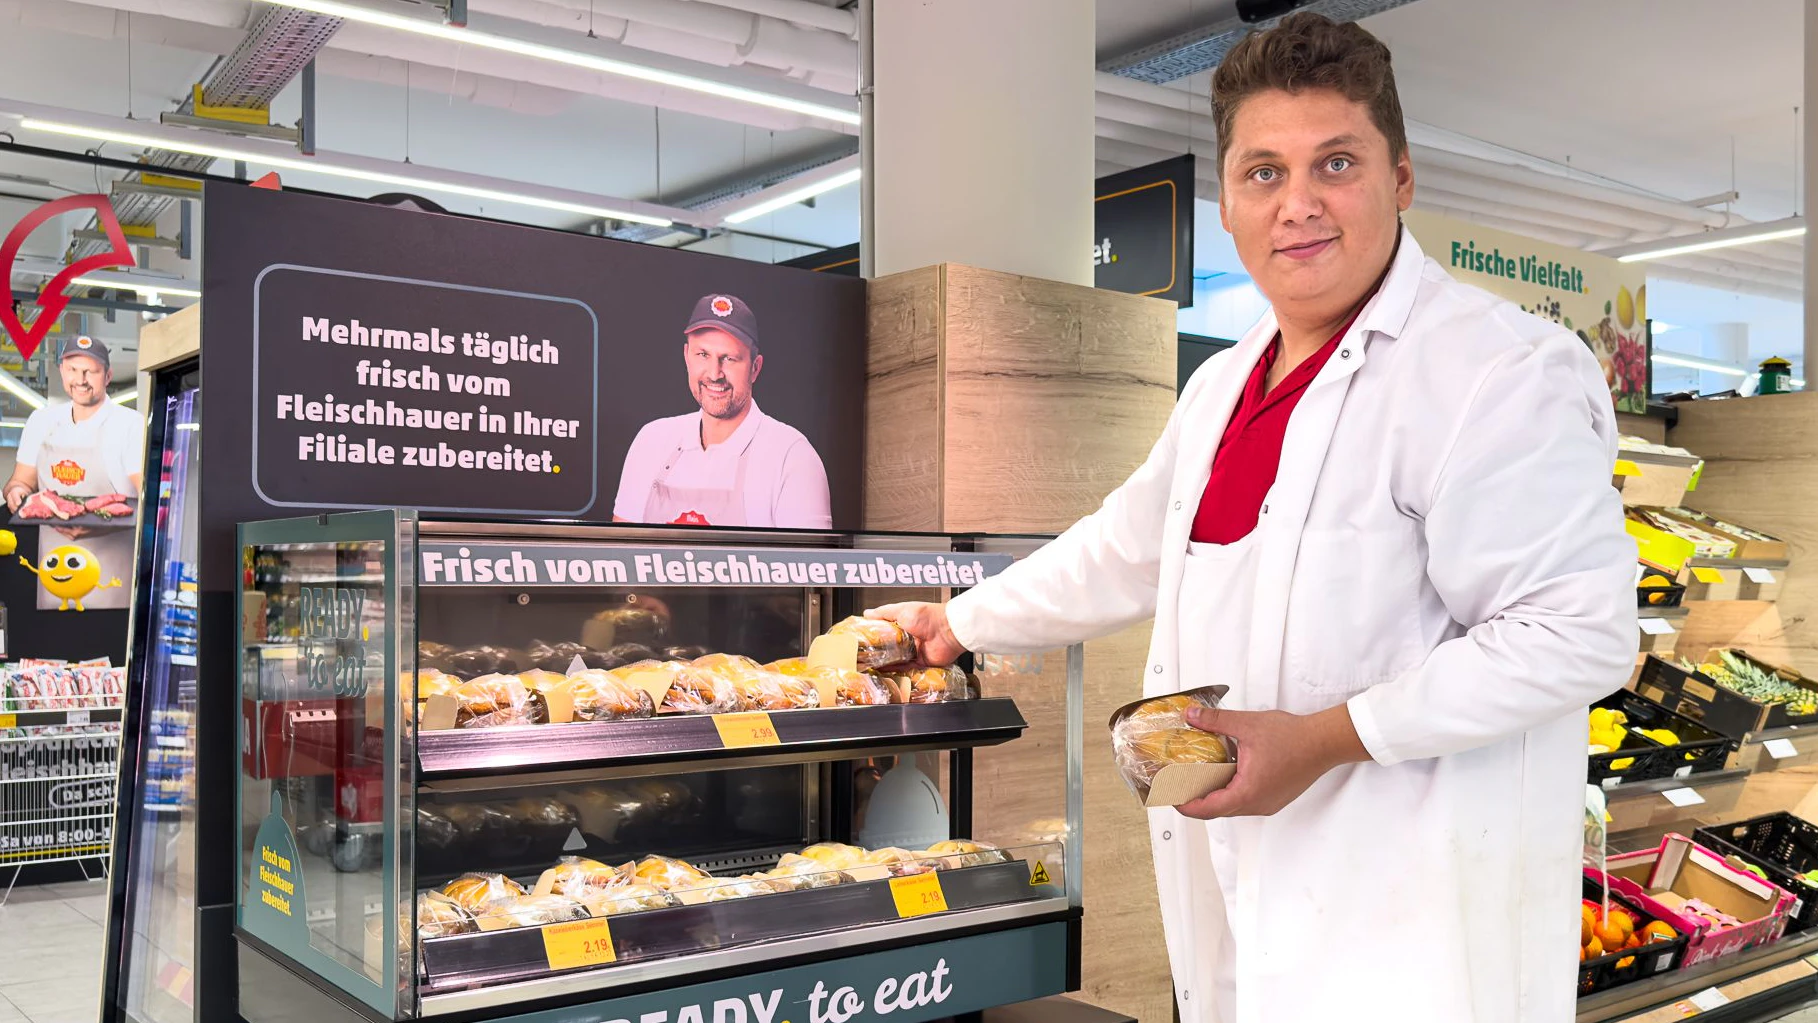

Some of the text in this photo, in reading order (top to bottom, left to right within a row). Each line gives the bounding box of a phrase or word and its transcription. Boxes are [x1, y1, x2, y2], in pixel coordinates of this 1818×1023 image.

[1451, 240, 1590, 294] Frische Vielfalt.
[302, 316, 559, 365] Mehrmals täglich
[356, 359, 510, 397] frisch vom
[277, 393, 580, 438] Fleischhauer in Ihrer
[298, 432, 561, 474] Filiale zubereitet.
[422, 547, 538, 582] Frisch
[544, 558, 627, 583] vom
[634, 551, 838, 584] Fleischhauer
[300, 587, 369, 641] READY.
[304, 638, 369, 698] to eat
[23, 833, 54, 846] von
[262, 845, 291, 873] Frisch vom
[260, 865, 294, 896] Fleischhauer
[262, 889, 292, 917] zubereitet.
[583, 938, 608, 953] 2.19
[808, 980, 865, 1023] to
[873, 957, 953, 1015] eat
